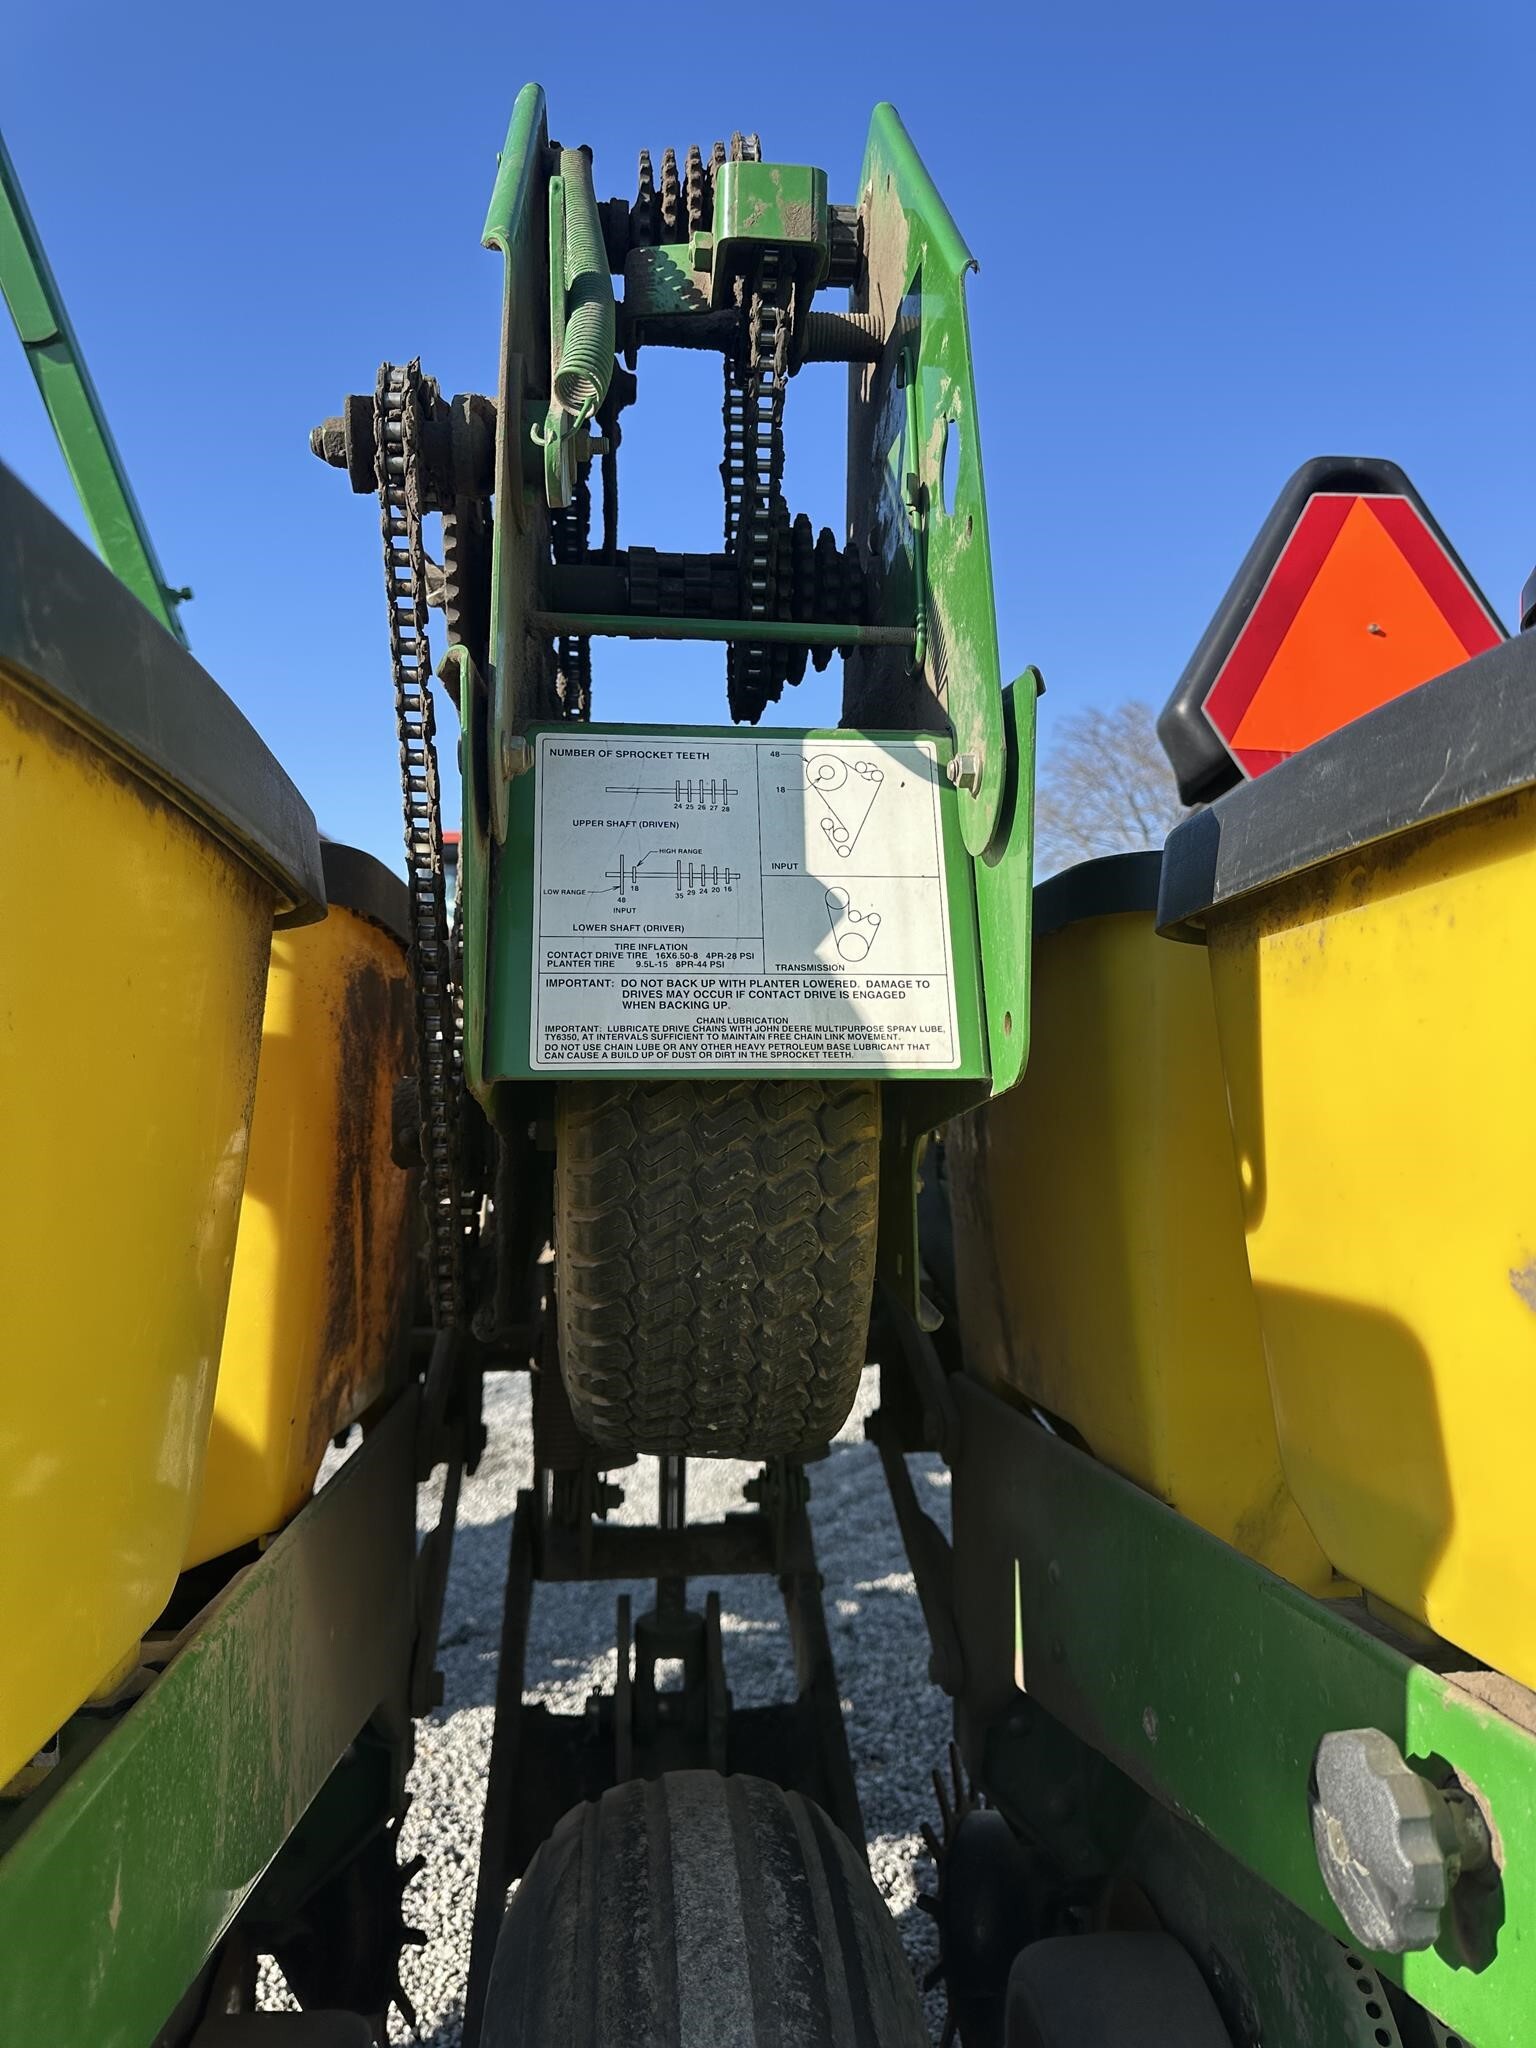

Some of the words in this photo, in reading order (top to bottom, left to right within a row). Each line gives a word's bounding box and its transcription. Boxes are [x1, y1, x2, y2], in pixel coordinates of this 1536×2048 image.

[550, 748, 597, 757] NUMBER
[598, 749, 613, 758] OF
[616, 750, 674, 759] SPROCKET
[676, 751, 710, 760] TEETH
[572, 819, 605, 828] UPPER
[606, 820, 638, 828] SHAFT
[638, 820, 680, 829] (DRIVEN)
[771, 862, 799, 870] INPUT
[543, 888, 560, 896] LOW
[560, 888, 587, 896] RANGE
[573, 923, 608, 932] LOWER
[608, 923, 641, 932] SHAFT
[643, 923, 685, 932] (DRIVER)
[547, 951, 594, 959] CONTACT
[595, 951, 624, 959] DRIVE
[626, 951, 648, 959] TIRE
[740, 952, 754, 960] PSI
[547, 960, 592, 968] PLANTER
[593, 960, 615, 968] TIRE
[774, 963, 845, 972] TRANSMISSION
[546, 979, 615, 988] IMPORTANT:
[621, 979, 638, 988] DO
[640, 979, 664, 988] NOT
[666, 979, 698, 988] BACK
[701, 979, 716, 988] UP
[718, 979, 746, 988] WITH
[750, 979, 800, 988] PLANTER
[803, 979, 860, 988] LOWERED.
[866, 979, 912, 988] DAMAGE
[916, 980, 930, 988] TO
[622, 990, 663, 999] DRIVES
[666, 990, 690, 999] MAY
[693, 990, 733, 999] OCCUR
[736, 990, 746, 999] IF
[748, 990, 801, 999] CONTACT
[804, 990, 837, 999] DRIVE
[839, 990, 850, 999] IS
[853, 990, 906, 999] ENGAGED
[622, 1001, 655, 1010] WHEN
[658, 1001, 710, 1010] BACKING
[713, 1001, 732, 1010] UP.
[545, 1025, 602, 1033] IMPORTANT:
[608, 1025, 660, 1033] LUBRICATE
[662, 1025, 690, 1033] DRIVE
[692, 1025, 727, 1033] CHAINS
[729, 1025, 752, 1033] WITH
[754, 1025, 780, 1033] JOHN
[782, 1025, 812, 1033] DEERE
[815, 1025, 884, 1033] MULTIPURPOSE
[887, 1025, 916, 1033] SPRAY
[920, 1025, 945, 1033] LUBE,
[544, 1033, 580, 1041] TY6350,
[582, 1033, 594, 1041] AT
[596, 1033, 649, 1041] INTERVALS
[650, 1033, 705, 1041] SUFFICIENT
[706, 1033, 720, 1041] TO
[722, 1033, 766, 1041] MAINTAIN
[768, 1033, 792, 1041] FREE
[794, 1033, 822, 1041] CHAIN
[824, 1033, 846, 1041] LINK
[847, 1033, 901, 1041] MOVEMENT.
[582, 1043, 602, 1051] USE
[604, 1043, 633, 1051] CHAIN
[636, 1043, 660, 1051] LUBE
[663, 1043, 677, 1051] OR
[679, 1043, 698, 1051] ANY
[700, 1043, 732, 1051] OTHER
[734, 1043, 766, 1051] HEAVY
[768, 1043, 824, 1051] PETROLEUM
[826, 1043, 851, 1051] BASE
[853, 1043, 904, 1051] LUBRICANT
[908, 1043, 930, 1051] THAT
[544, 1052, 565, 1060] CAN
[611, 1051, 639, 1059] BUILD
[641, 1051, 654, 1059] UP
[656, 1051, 670, 1059] OF
[672, 1051, 697, 1059] DUST
[698, 1051, 713, 1059] OR
[715, 1051, 736, 1059] DIRT
[738, 1051, 748, 1059] IN
[749, 1051, 768, 1059] THE
[770, 1051, 820, 1059] SPROCKET
[822, 1051, 855, 1059] TEETH.
